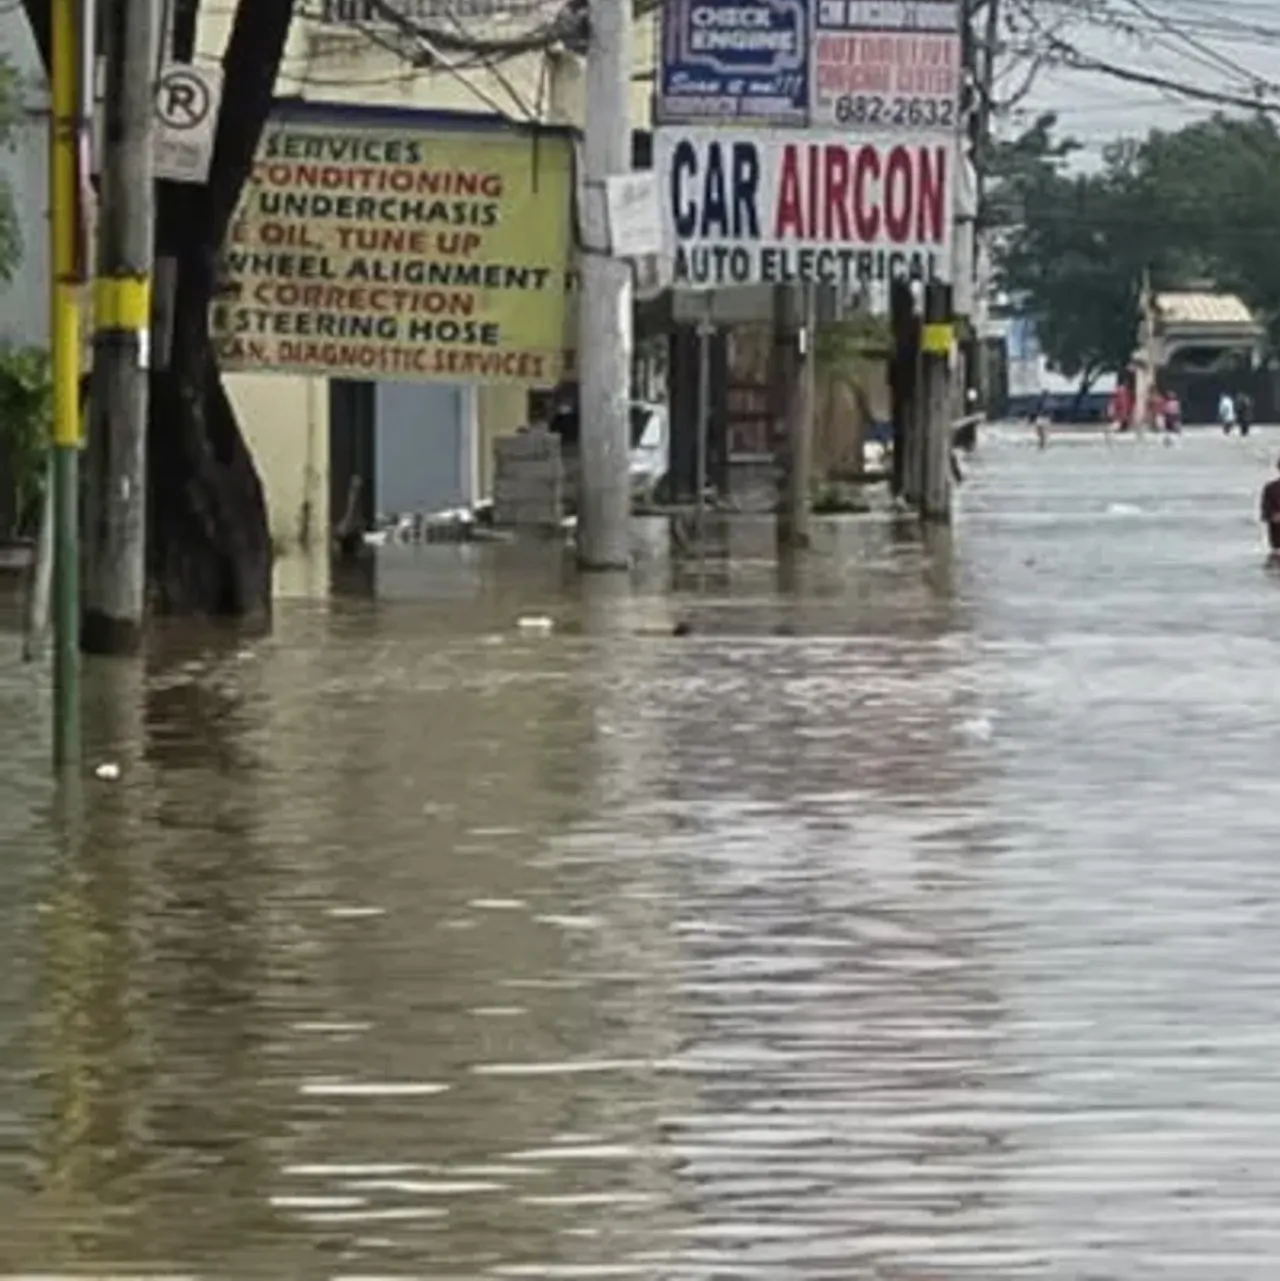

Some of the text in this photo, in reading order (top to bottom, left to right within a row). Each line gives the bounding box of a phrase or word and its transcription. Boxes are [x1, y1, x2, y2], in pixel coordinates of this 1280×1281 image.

[264, 131, 422, 164] SERVICES
[259, 192, 500, 227] UNDERCHASIS
[671, 140, 947, 244] CAR AIRCON
[337, 227, 426, 254] TUNE
[437, 232, 482, 258] UP
[346, 258, 550, 292] ALIGNMENT
[674, 246, 939, 284] AUTO ELECTRICAL
[253, 281, 475, 316] CORRECTION
[234, 308, 398, 341] STEERING
[407, 320, 500, 346] HOSE
